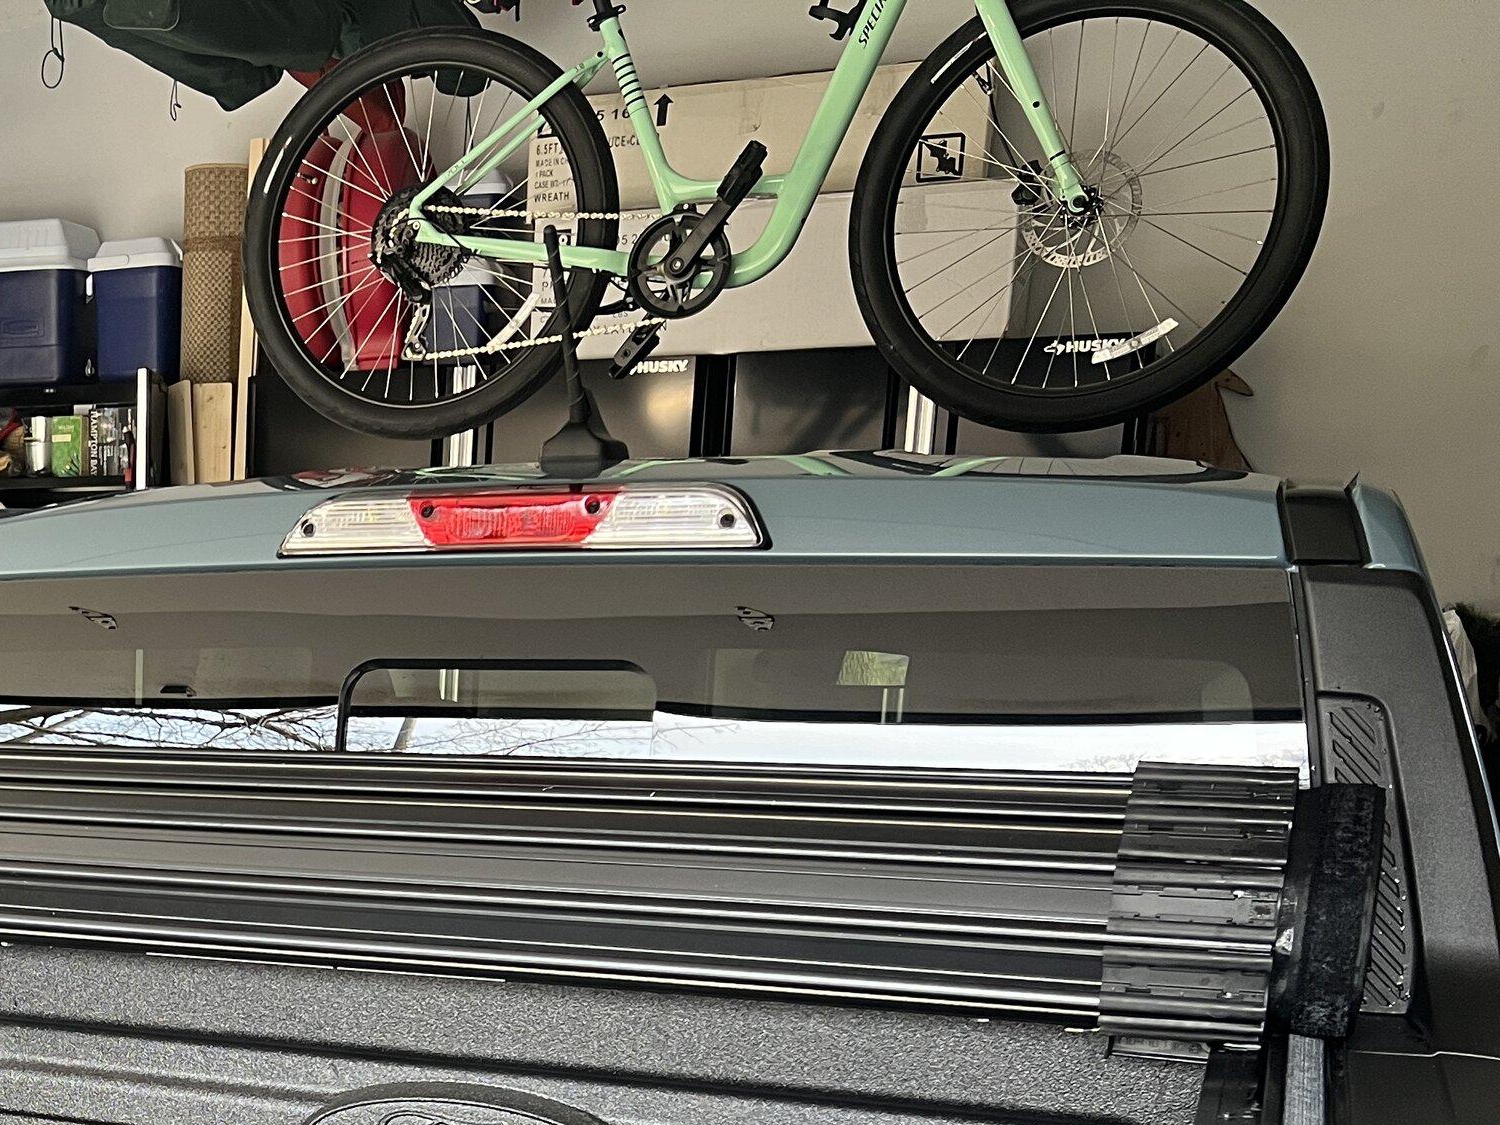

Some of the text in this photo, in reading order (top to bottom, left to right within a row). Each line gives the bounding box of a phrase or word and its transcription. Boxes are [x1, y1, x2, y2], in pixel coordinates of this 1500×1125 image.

[534, 191, 570, 203] WREATH
[637, 359, 689, 374] HUSKY
[90, 410, 99, 457] HAMPTON
